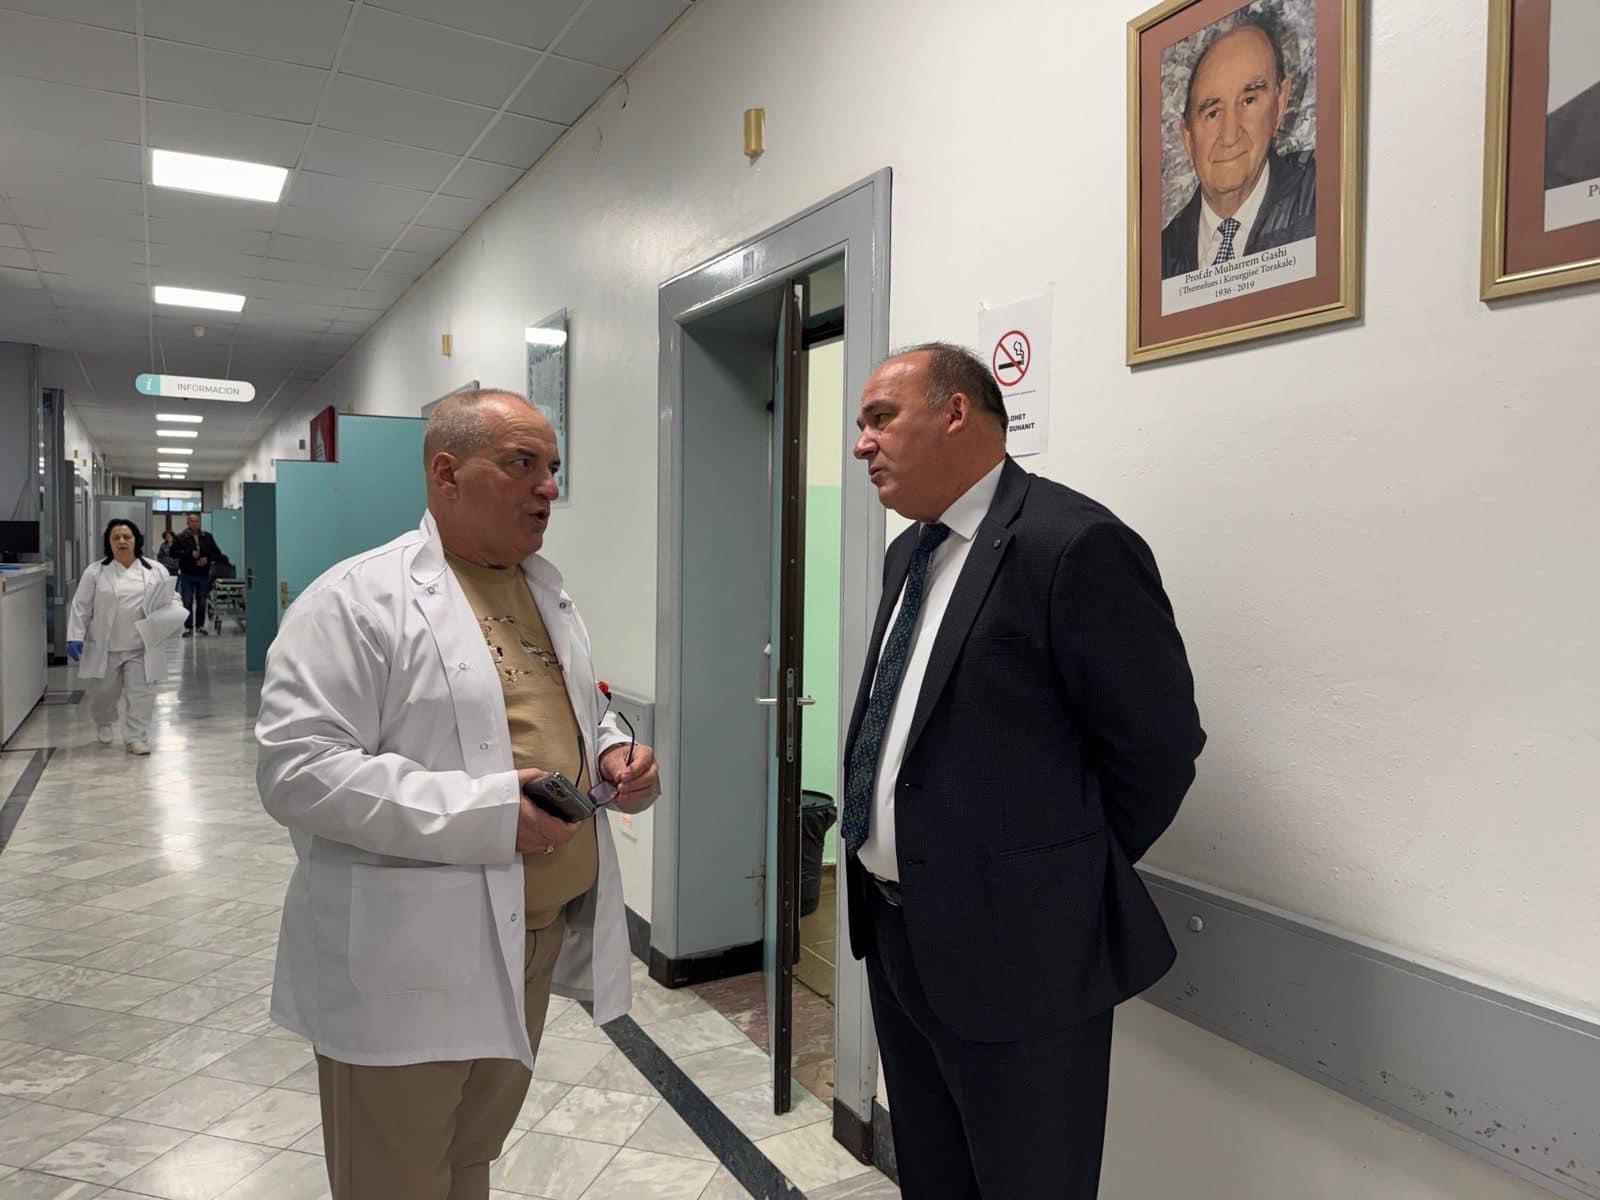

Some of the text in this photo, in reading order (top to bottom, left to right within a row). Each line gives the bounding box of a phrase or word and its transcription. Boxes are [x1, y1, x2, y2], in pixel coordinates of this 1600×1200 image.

[1214, 257, 1260, 276] Muharrem
[1260, 247, 1287, 262] Gashi
[1237, 280, 1255, 293] 2019
[177, 383, 240, 396] INFORMACION
